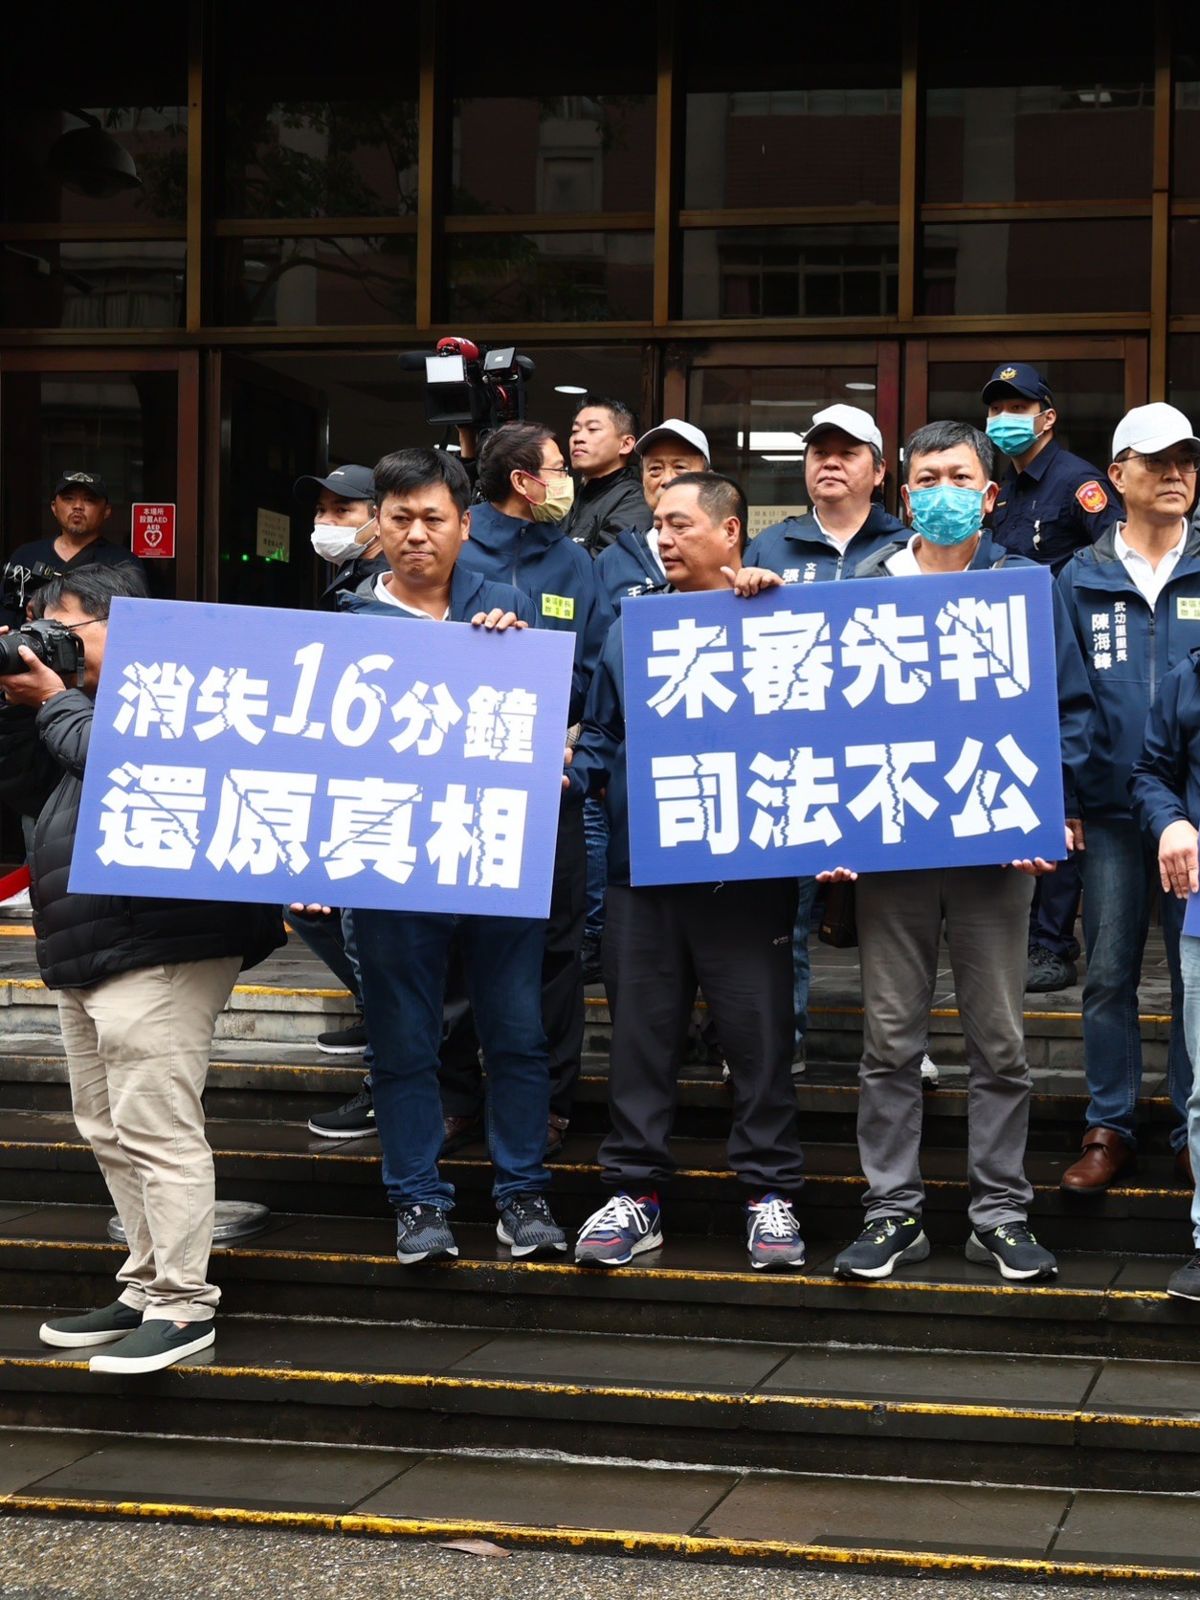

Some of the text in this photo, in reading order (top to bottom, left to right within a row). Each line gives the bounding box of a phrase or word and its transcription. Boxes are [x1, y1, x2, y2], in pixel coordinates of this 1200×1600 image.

[647, 595, 1031, 719] 未審先判
[1114, 601, 1127, 662] 武功里里長
[113, 642, 537, 763] 消失16分鐘
[96, 762, 529, 889] 還原真相
[652, 735, 1041, 856] 司法不公
